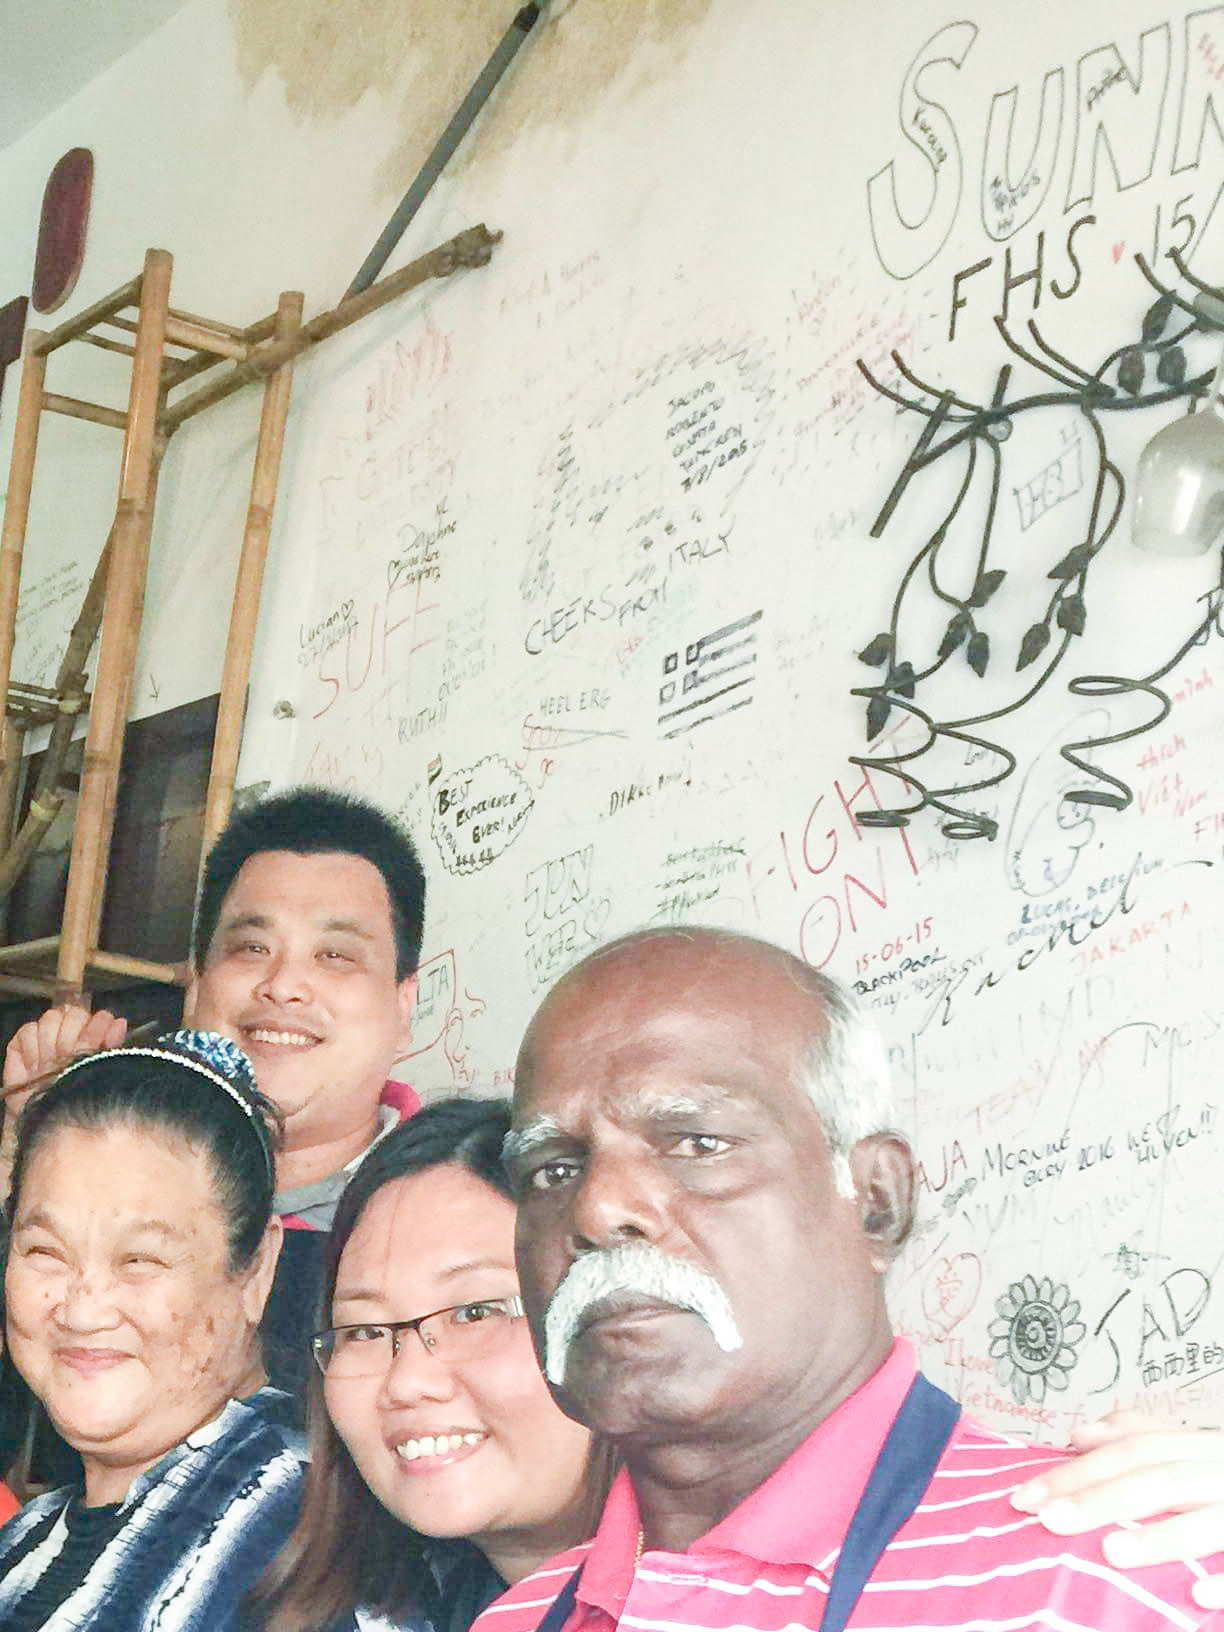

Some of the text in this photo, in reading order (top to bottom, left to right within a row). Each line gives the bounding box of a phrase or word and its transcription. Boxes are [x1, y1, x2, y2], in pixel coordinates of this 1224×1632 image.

[668, 514, 737, 570] ITALY
[437, 776, 474, 817] BEST
[855, 915, 934, 976] 15-06-15
[1070, 900, 1193, 978] JAKARTA
